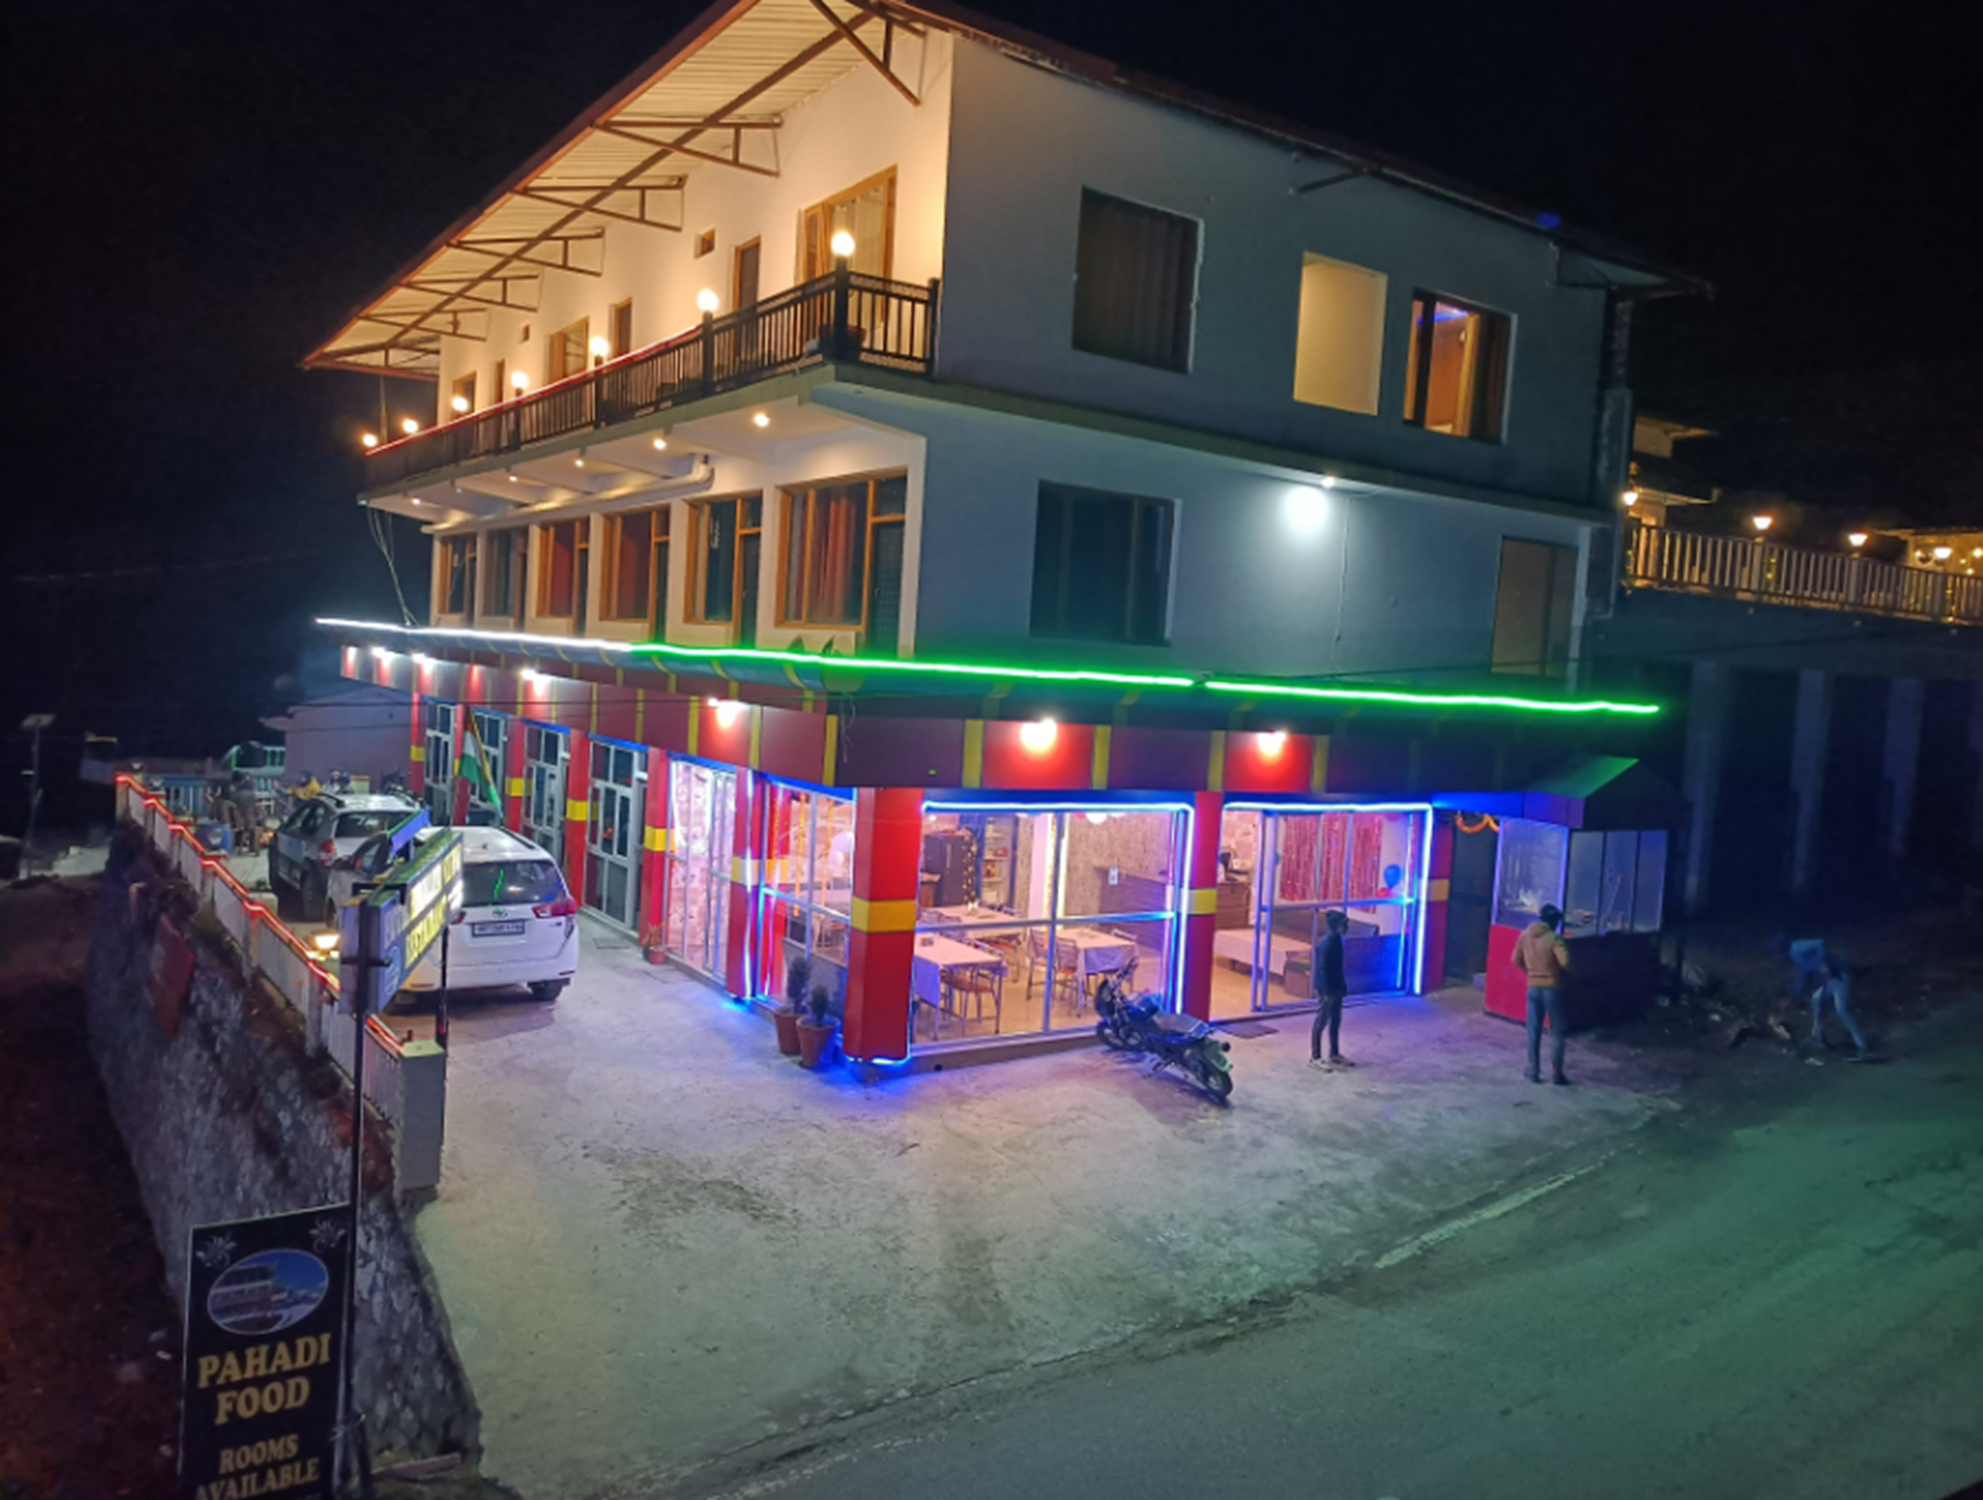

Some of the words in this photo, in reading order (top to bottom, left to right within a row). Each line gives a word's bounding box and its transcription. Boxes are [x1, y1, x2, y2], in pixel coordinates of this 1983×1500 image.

[198, 1333, 331, 1388] PAHADI
[215, 1376, 310, 1425] FOOD
[218, 1434, 299, 1474] ROOMS
[195, 1457, 321, 1500] AVAILABLE
